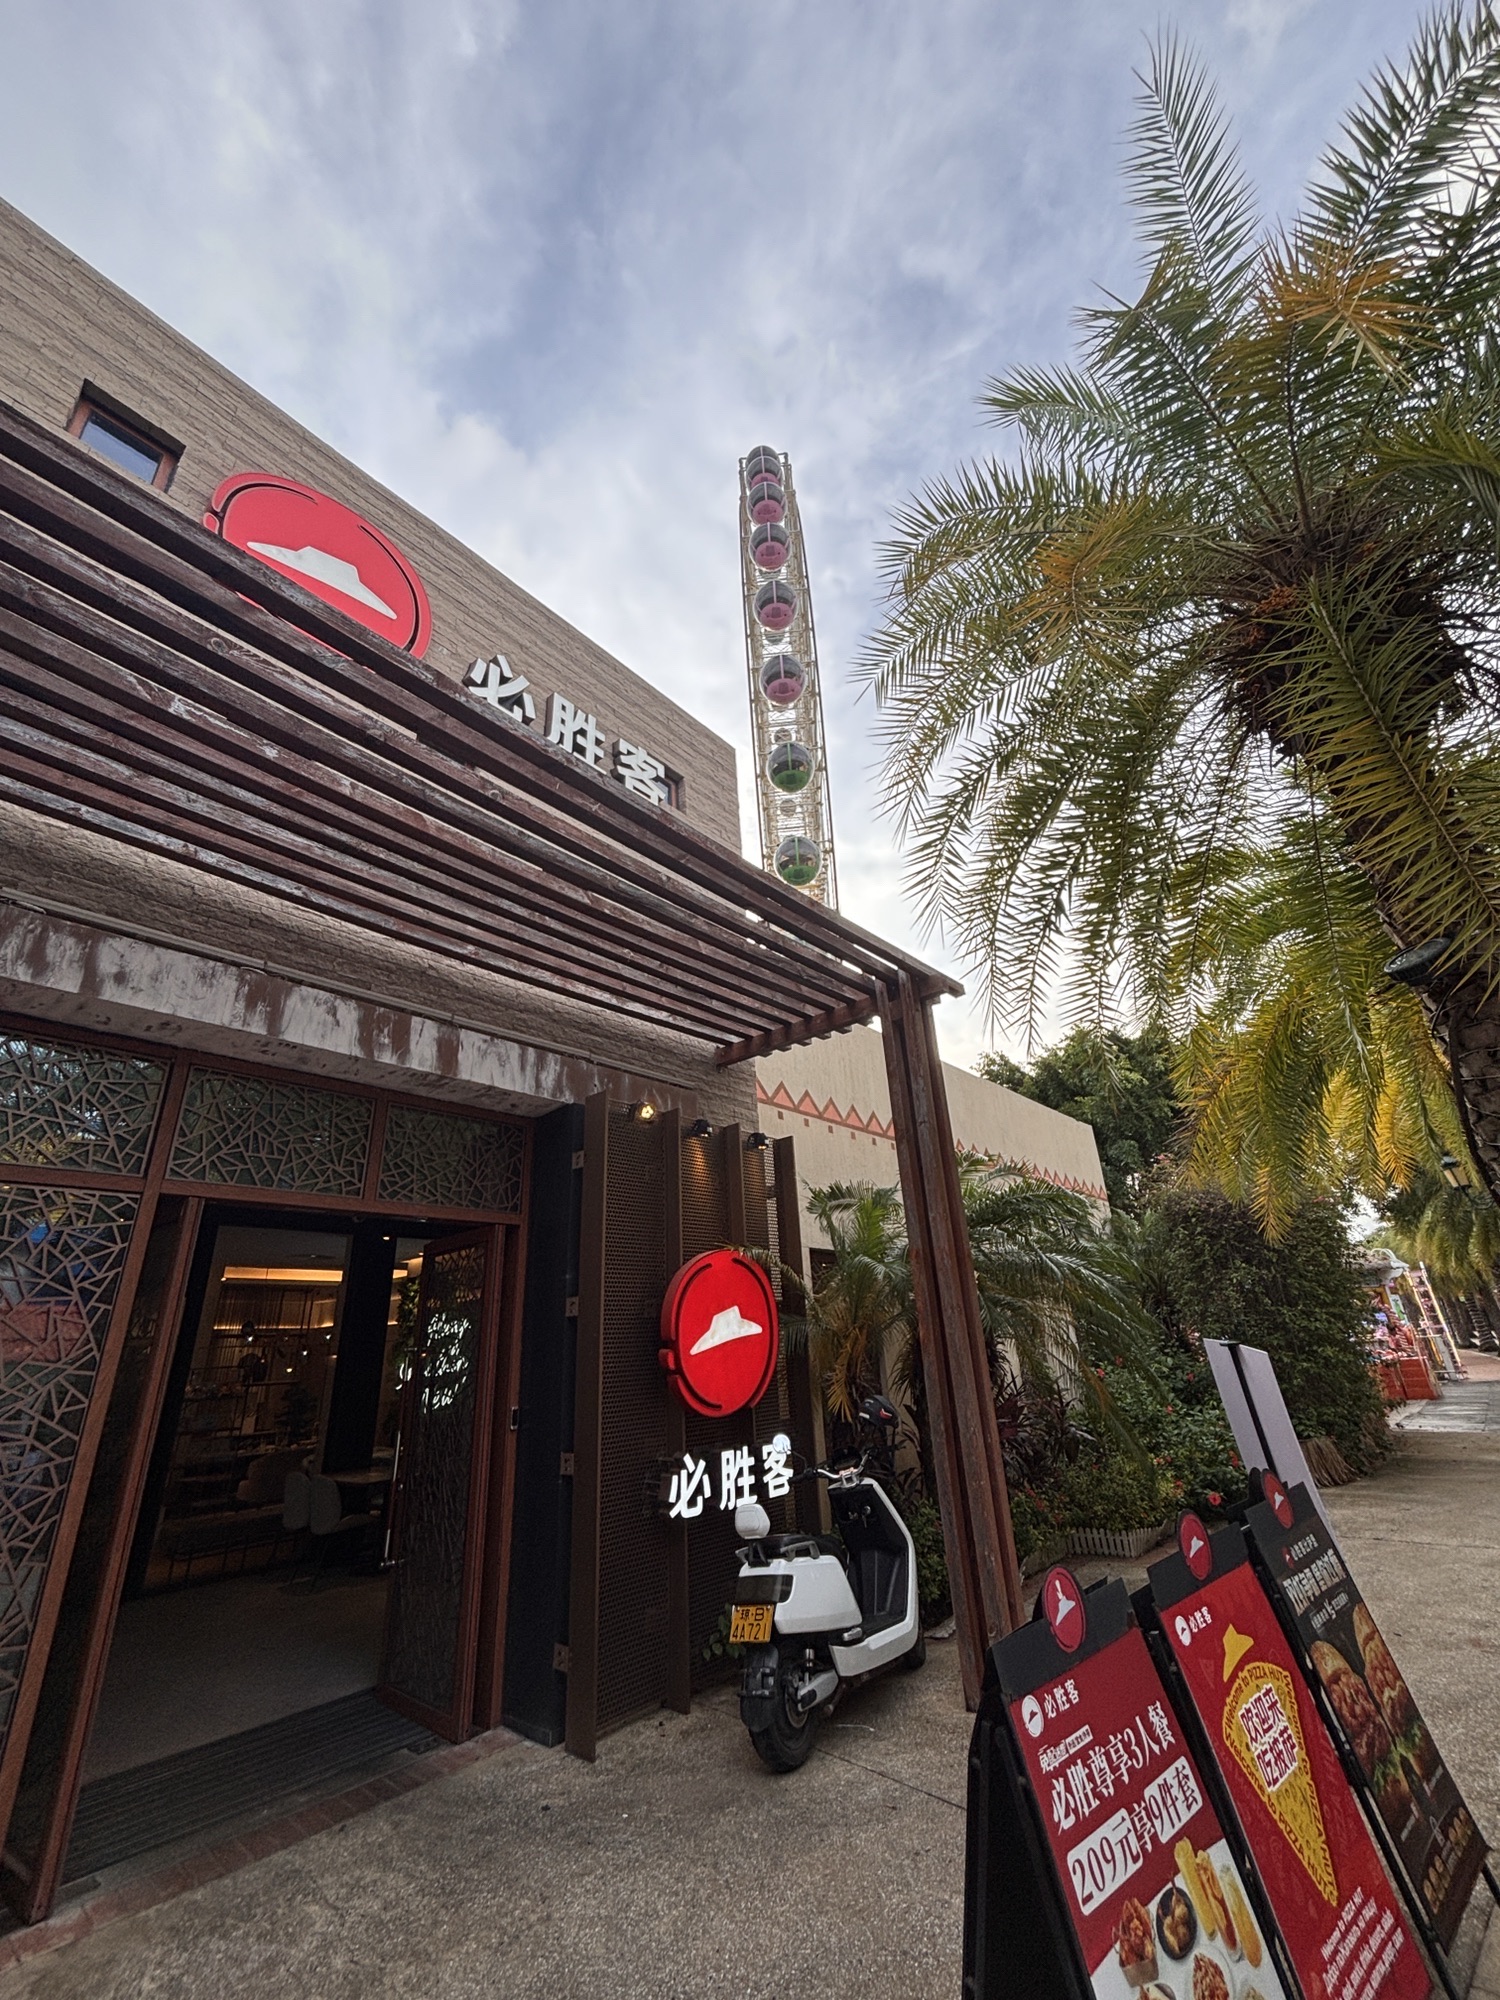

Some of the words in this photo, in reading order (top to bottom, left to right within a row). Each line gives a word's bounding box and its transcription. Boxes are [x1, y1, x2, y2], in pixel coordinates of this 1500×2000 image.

[463, 655, 666, 805] 必胜客
[668, 1444, 794, 1519] 必胜客
[732, 1623, 767, 1640] 4A721
[1188, 1606, 1212, 1633] 必胜客
[1043, 1678, 1080, 1719] 必胜客
[1224, 1681, 1245, 1730] Welcome
[1247, 1667, 1268, 1683] PIZZA
[1269, 1668, 1285, 1683] HUT
[1239, 1687, 1285, 1745] 欢迎来
[1051, 1700, 1176, 1836] 必胜尊享3人餐
[1255, 1725, 1297, 1789] 吃披萨
